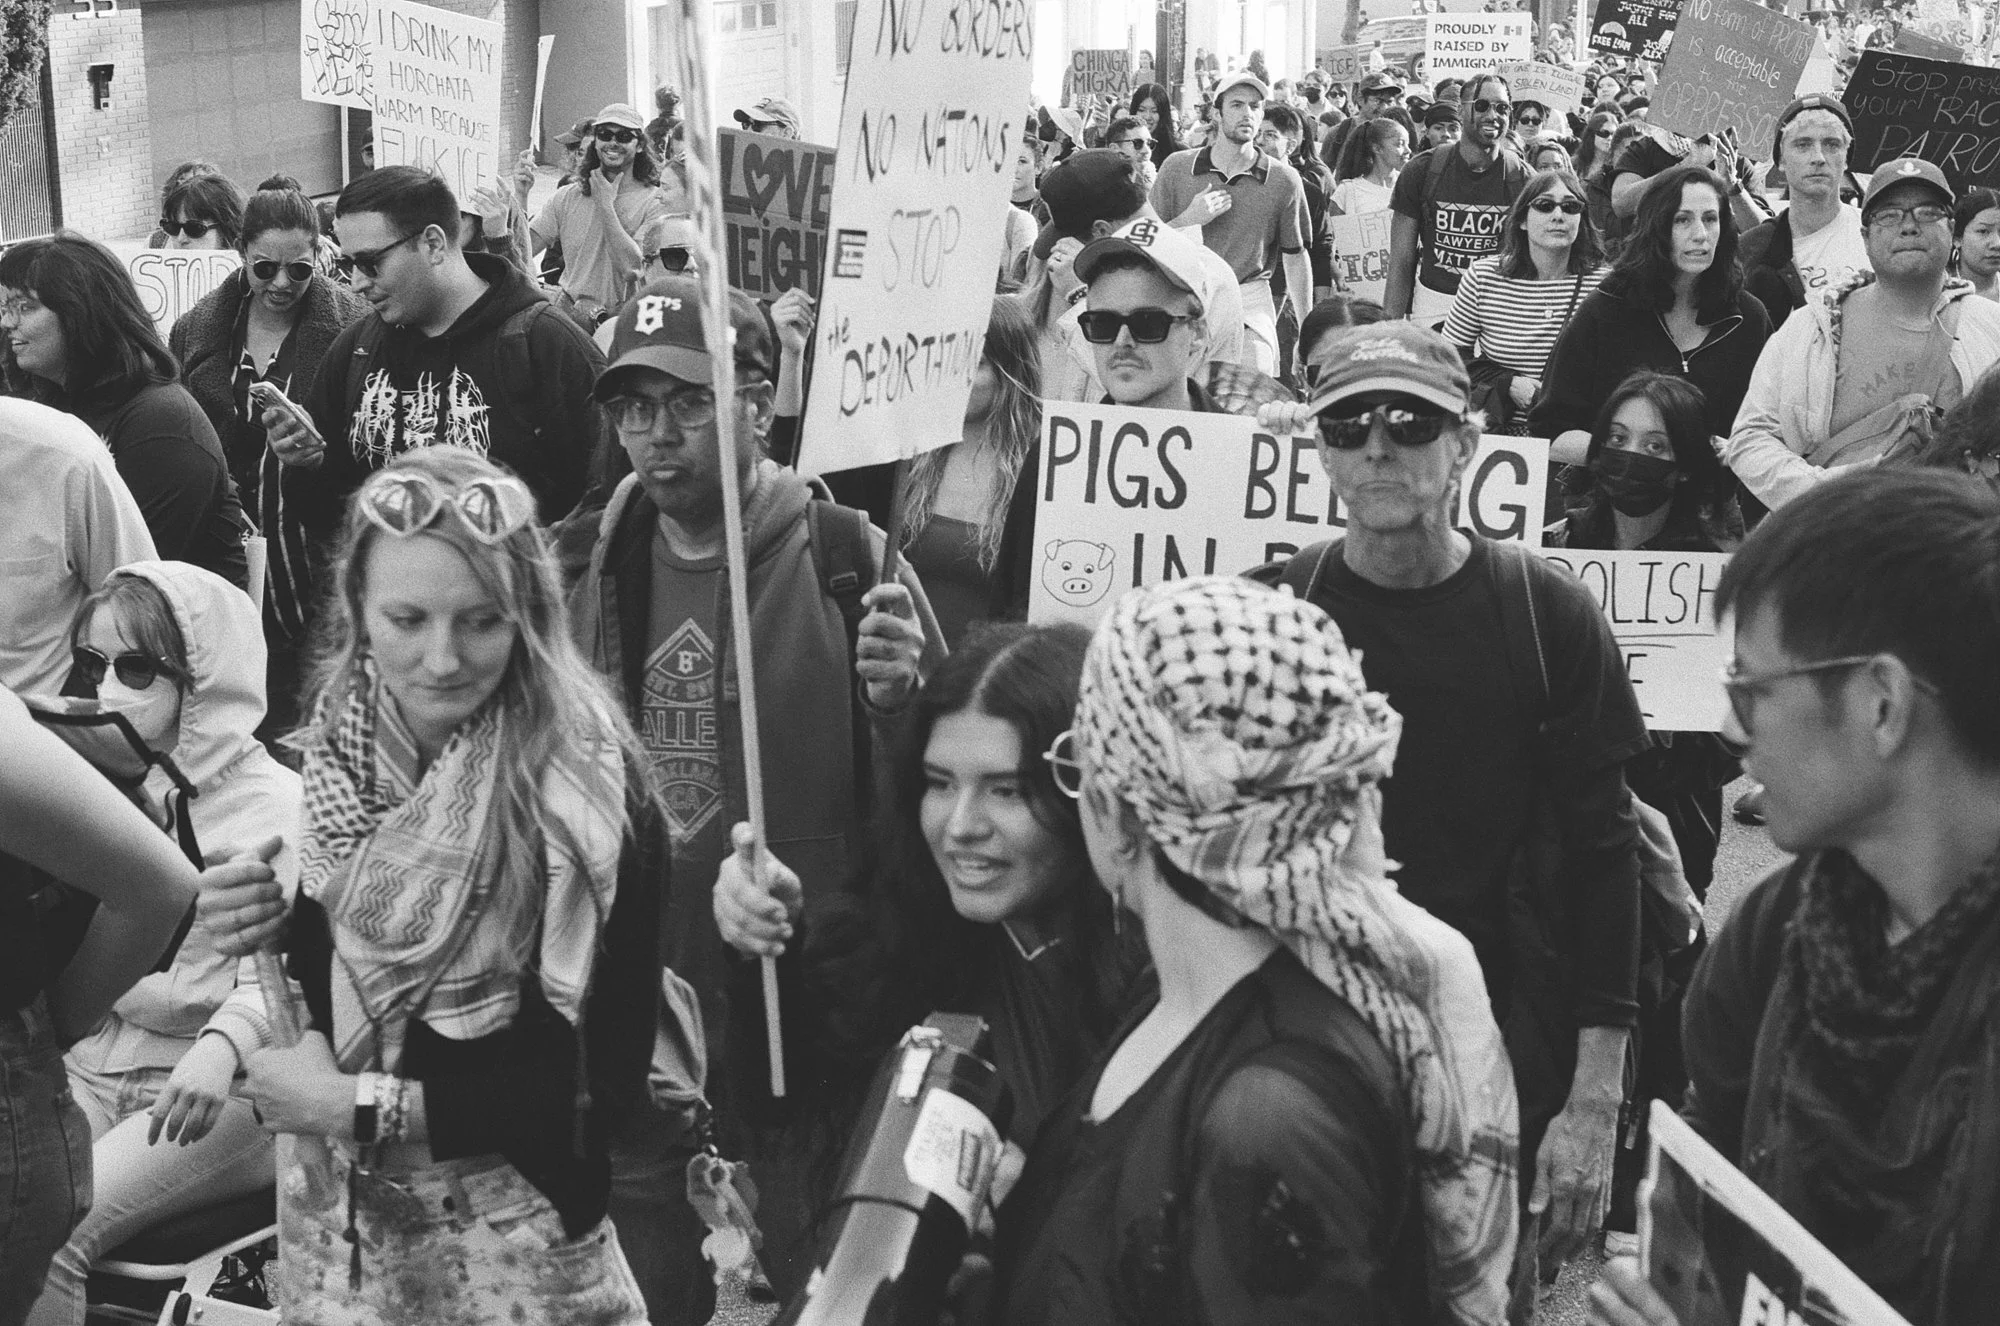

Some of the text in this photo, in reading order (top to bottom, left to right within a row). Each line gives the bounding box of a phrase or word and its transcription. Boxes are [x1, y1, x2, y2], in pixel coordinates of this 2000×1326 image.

[1617, 1, 1678, 22] JUSTICE FOR
[1627, 14, 1649, 27] ALL
[1688, 0, 1712, 21] NO
[1751, 12, 1771, 42] of
[378, 8, 493, 75] I DRINK MY
[874, 0, 926, 61] NO
[1434, 23, 1497, 35] PROUDLY
[1592, 34, 1612, 47] FREE
[1433, 40, 1510, 53] RAISED BY
[1073, 50, 1130, 72] CHINGA
[1432, 57, 1525, 69] IMMIGRA
[1714, 45, 1781, 89] acceptable
[389, 61, 474, 103] HORCHATA
[1073, 71, 1131, 95] MIGRA
[374, 94, 491, 142] WARM BECAUSE
[1849, 92, 1917, 120] your
[853, 109, 896, 183] NO
[380, 126, 490, 204] FUCK ICE
[1436, 209, 1508, 234] BLACK
[882, 204, 960, 292] STOP
[1436, 232, 1499, 250] LAWYERS
[1433, 247, 1488, 268] MATT
[1044, 415, 1193, 510] PIGS
[1546, 557, 1726, 625] OLISH
